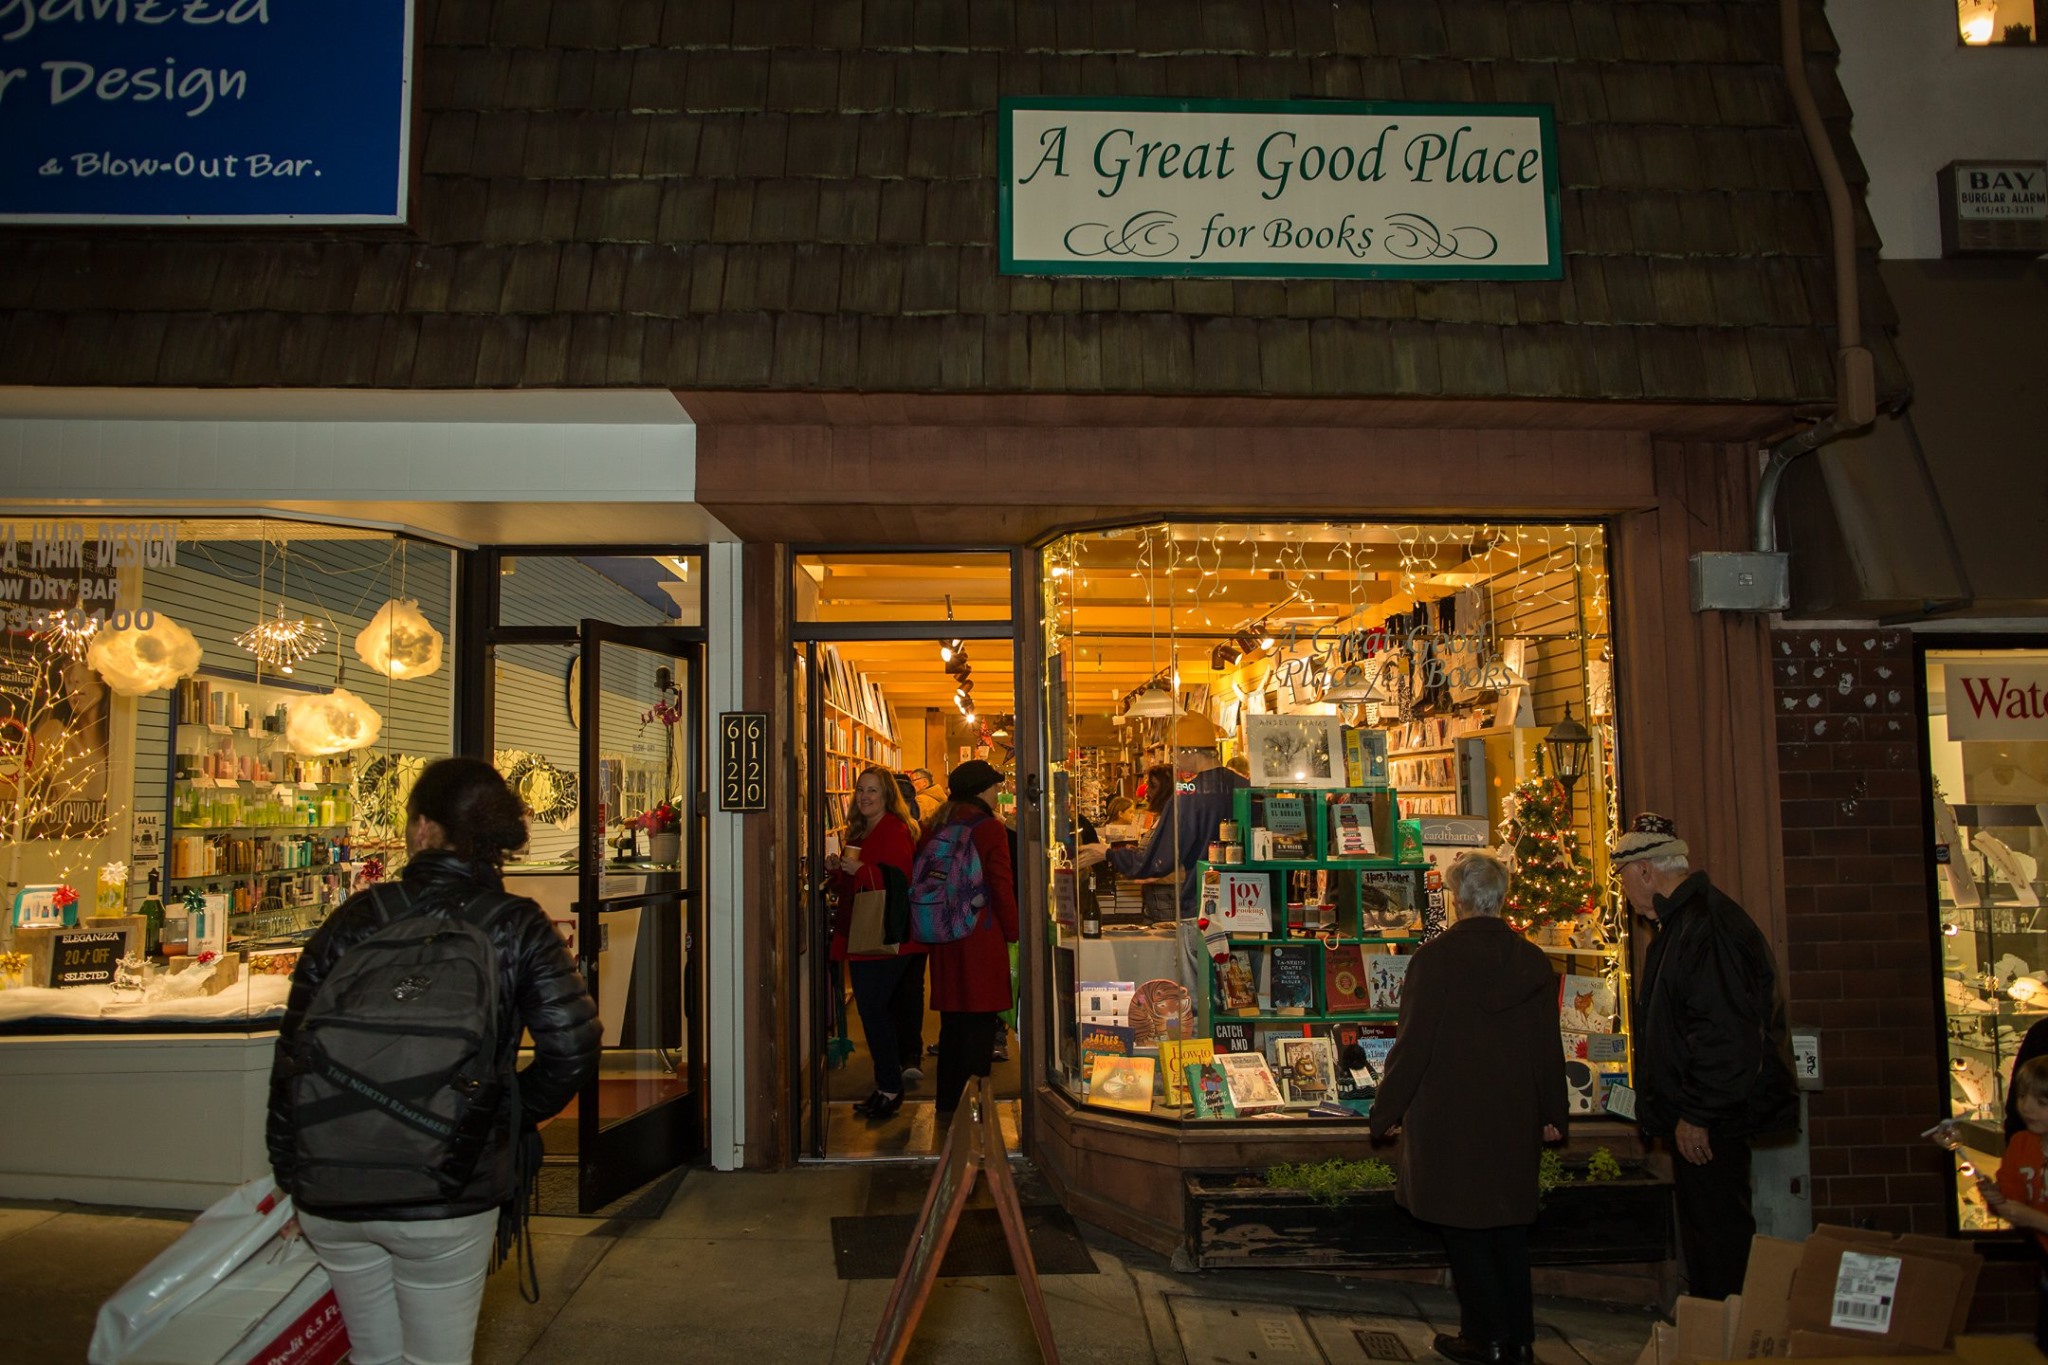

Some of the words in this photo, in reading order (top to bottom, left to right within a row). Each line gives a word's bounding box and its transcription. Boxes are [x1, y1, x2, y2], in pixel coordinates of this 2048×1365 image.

[41, 57, 247, 117] Design
[38, 156, 63, 175] &
[71, 152, 237, 177] Blow-Out
[245, 154, 322, 177] Bar.
[1018, 125, 1070, 185] A
[1093, 128, 1236, 198] Great
[1256, 125, 1399, 200] Good
[1404, 126, 1540, 185] Place
[1970, 172, 2035, 190] BAY
[1962, 192, 2006, 203] BURGLAR
[2011, 192, 2046, 203] ALARM
[1189, 213, 1255, 260] for
[1263, 214, 1374, 258] Books
[0, 523, 18, 568] A
[31, 523, 84, 568] HAIR
[97, 523, 177, 568] DESIGN
[29, 578, 73, 600] DRY
[80, 578, 122, 600] BAR
[1312, 624, 1396, 664] Great
[1407, 620, 1493, 665] Good
[1276, 657, 1361, 689] Place
[1424, 654, 1513, 697] Books
[137, 816, 157, 825] SALE
[1423, 830, 1475, 842] cardthartic
[1366, 872, 1386, 883] Harry
[1386, 871, 1409, 883] Potter
[1225, 877, 1263, 918] joy
[1238, 898, 1246, 906] of
[1236, 906, 1264, 915] cooking
[62, 932, 120, 944] ELEGANZZA
[92, 948, 110, 964] OFF
[64, 970, 110, 982] SELECTED
[1215, 1025, 1244, 1038] CATCH
[1231, 1038, 1249, 1051] AND
[326, 1065, 351, 1084] THE
[347, 1077, 390, 1106] NORTH
[388, 1098, 453, 1136] REMEMBERS
